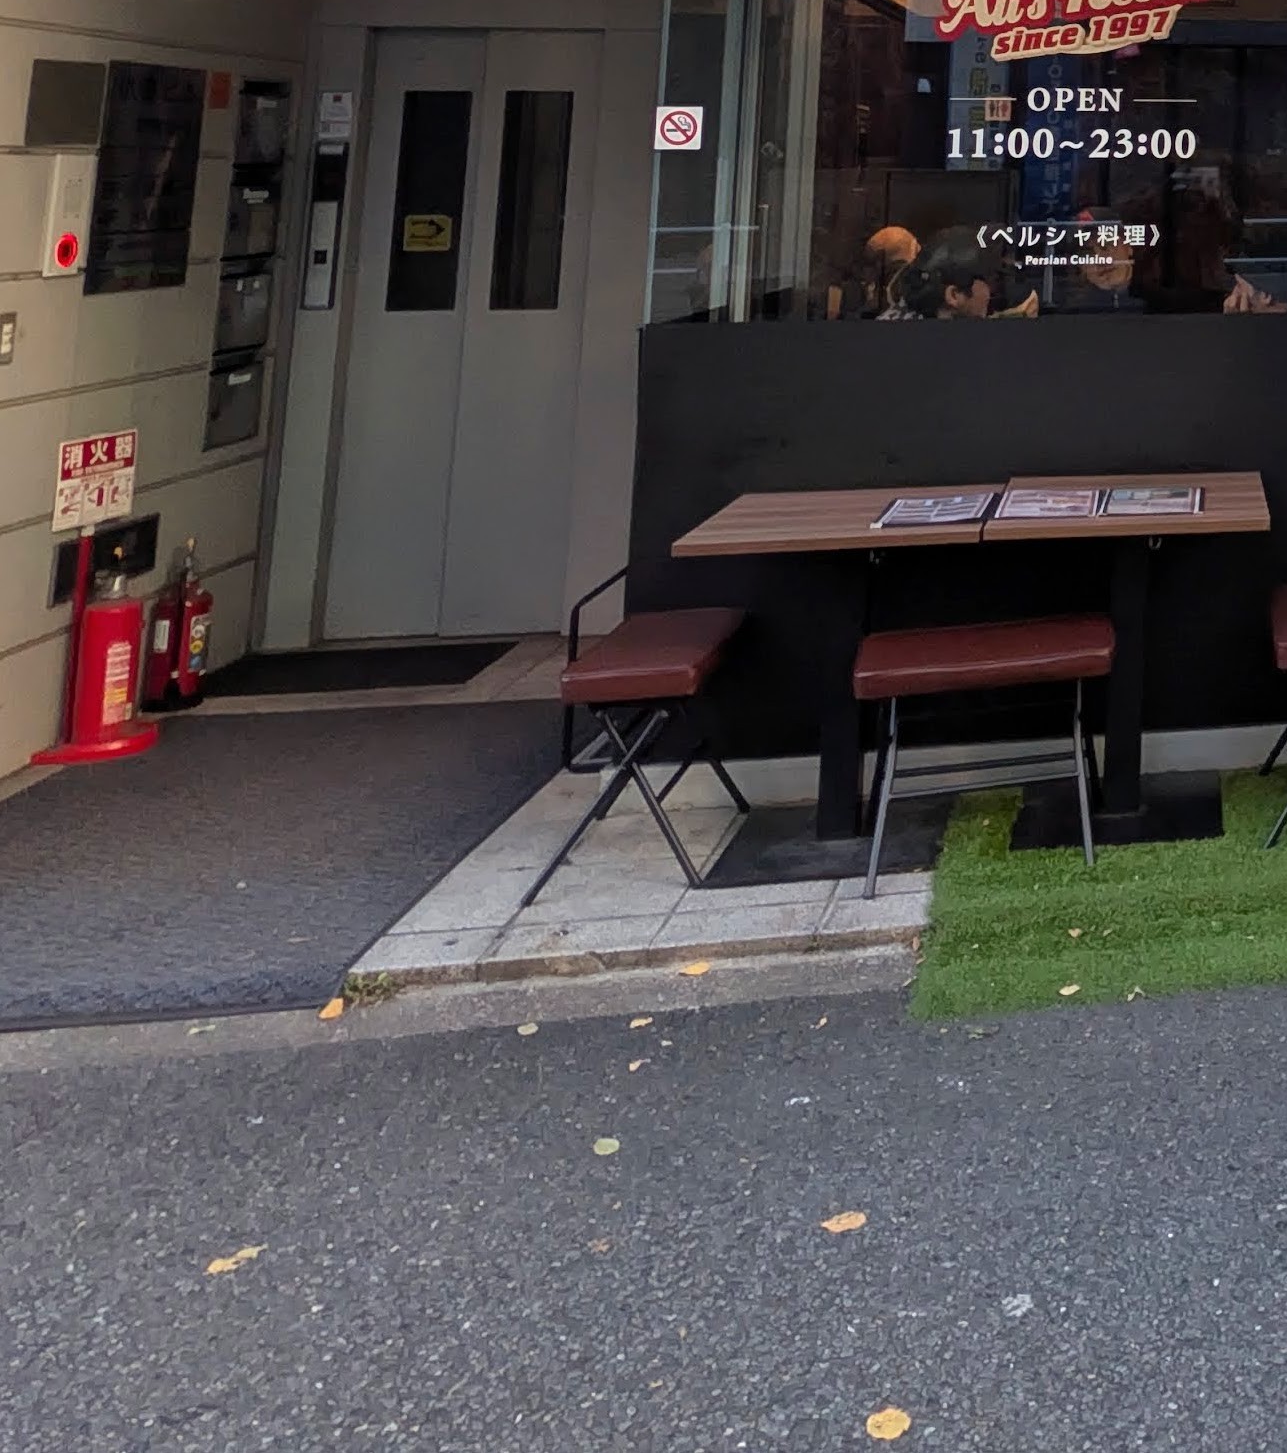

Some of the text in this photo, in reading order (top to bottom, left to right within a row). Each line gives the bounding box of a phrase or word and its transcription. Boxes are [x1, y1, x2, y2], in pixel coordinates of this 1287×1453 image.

[994, 10, 1170, 55] since 1997
[1027, 88, 1123, 112] OPEN
[1025, 254, 1113, 266] Persian Cuisine
[64, 435, 134, 470] 消火器
